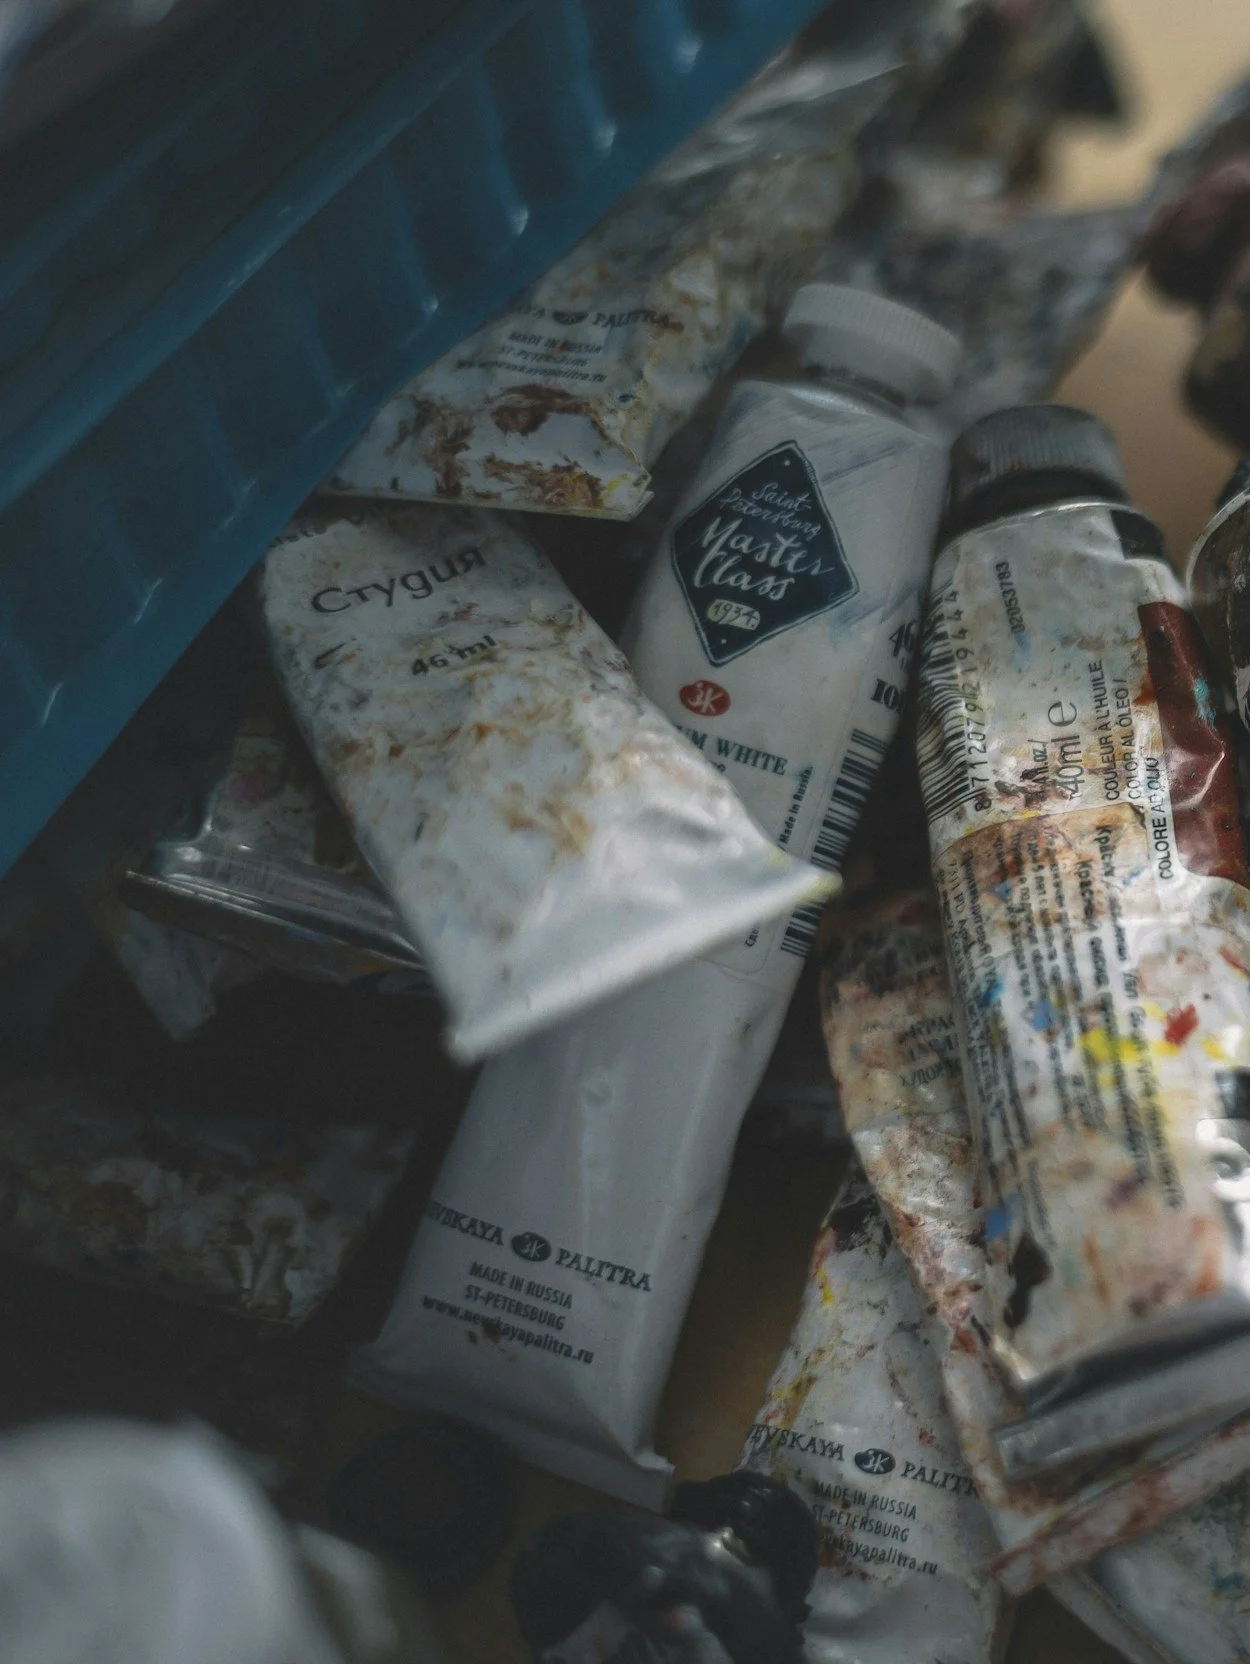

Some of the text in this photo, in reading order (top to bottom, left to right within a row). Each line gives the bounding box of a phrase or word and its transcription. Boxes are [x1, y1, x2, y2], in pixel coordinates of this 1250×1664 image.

[693, 548, 797, 603] Class
[700, 515, 837, 590] Master
[310, 546, 487, 614] Студия
[409, 653, 450, 677] 46
[716, 736, 788, 776] WHITE
[1099, 735, 1120, 800] COULEUR
[777, 815, 797, 845] Made
[1152, 817, 1174, 880] COLORE
[469, 1261, 574, 1310] MADE IN RUSSIA
[555, 1247, 653, 1292] PALITRA
[463, 1283, 567, 1332] ST-PETERSBURG
[811, 1503, 910, 1544] ST-PETERSBURG
[814, 1480, 918, 1520] MADE IN RUSSIA
